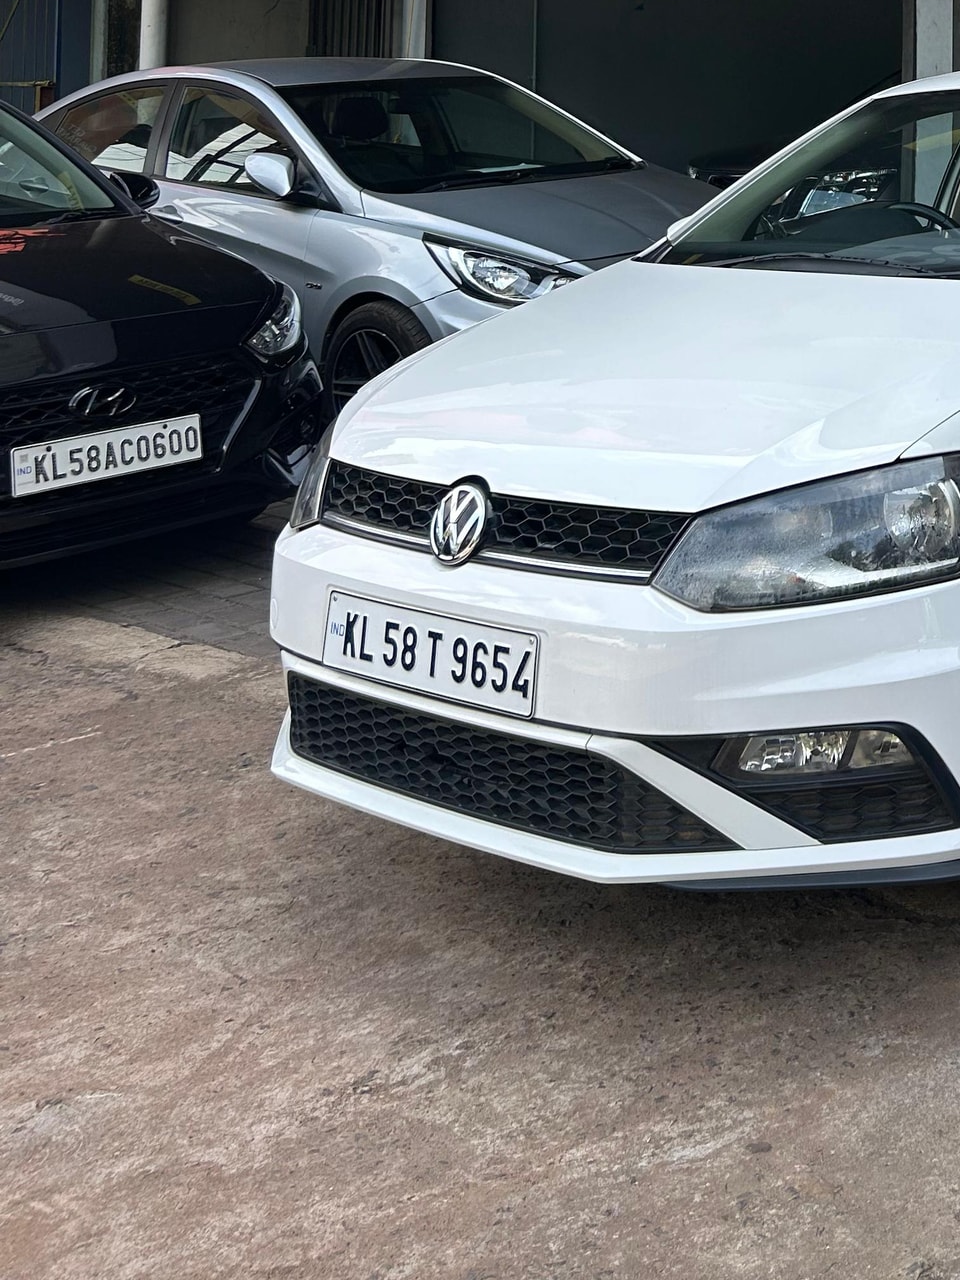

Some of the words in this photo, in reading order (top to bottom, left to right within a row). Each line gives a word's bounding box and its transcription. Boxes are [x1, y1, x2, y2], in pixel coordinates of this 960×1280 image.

[16, 466, 32, 476] IND
[34, 426, 200, 484] KL58AC0600
[330, 621, 345, 637] IND
[343, 611, 374, 663] KL
[382, 621, 418, 671] 58
[427, 630, 444, 678] T
[451, 637, 532, 699] 9654
